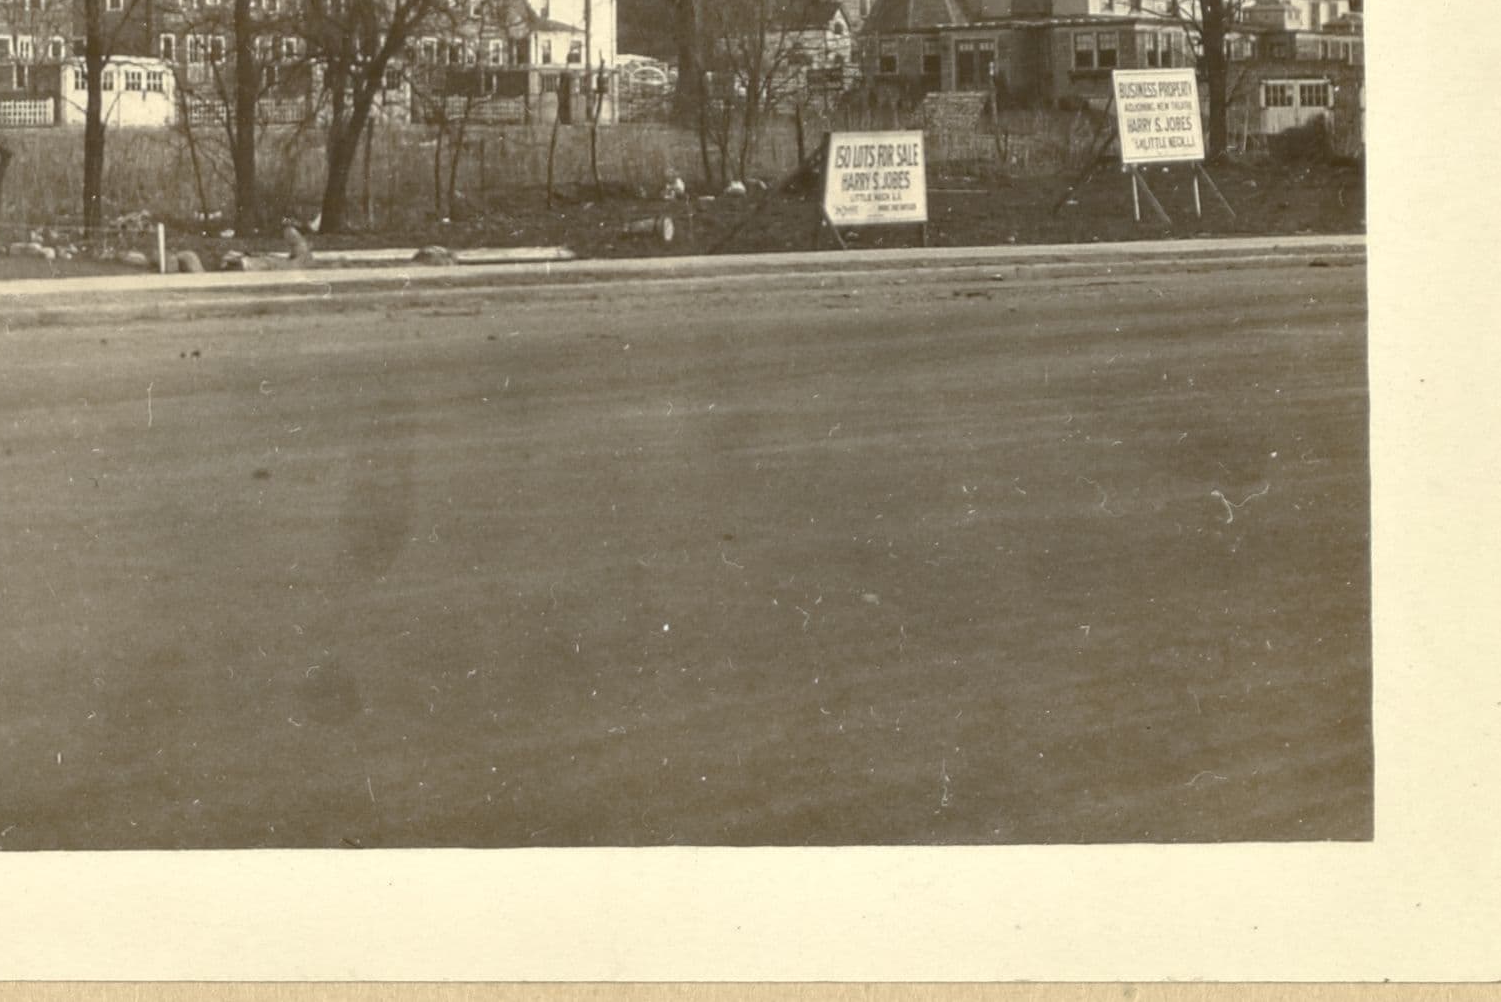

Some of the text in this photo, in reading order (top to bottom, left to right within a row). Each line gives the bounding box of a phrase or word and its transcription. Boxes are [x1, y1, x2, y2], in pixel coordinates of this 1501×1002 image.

[1119, 82, 1157, 99] BUSINESS
[1127, 118, 1151, 134] HARRY
[1164, 116, 1193, 132] JOBES
[835, 143, 919, 168] 150 LOTS FOR SALE
[842, 172, 870, 191] HARRY
[882, 170, 911, 190] JOBES
